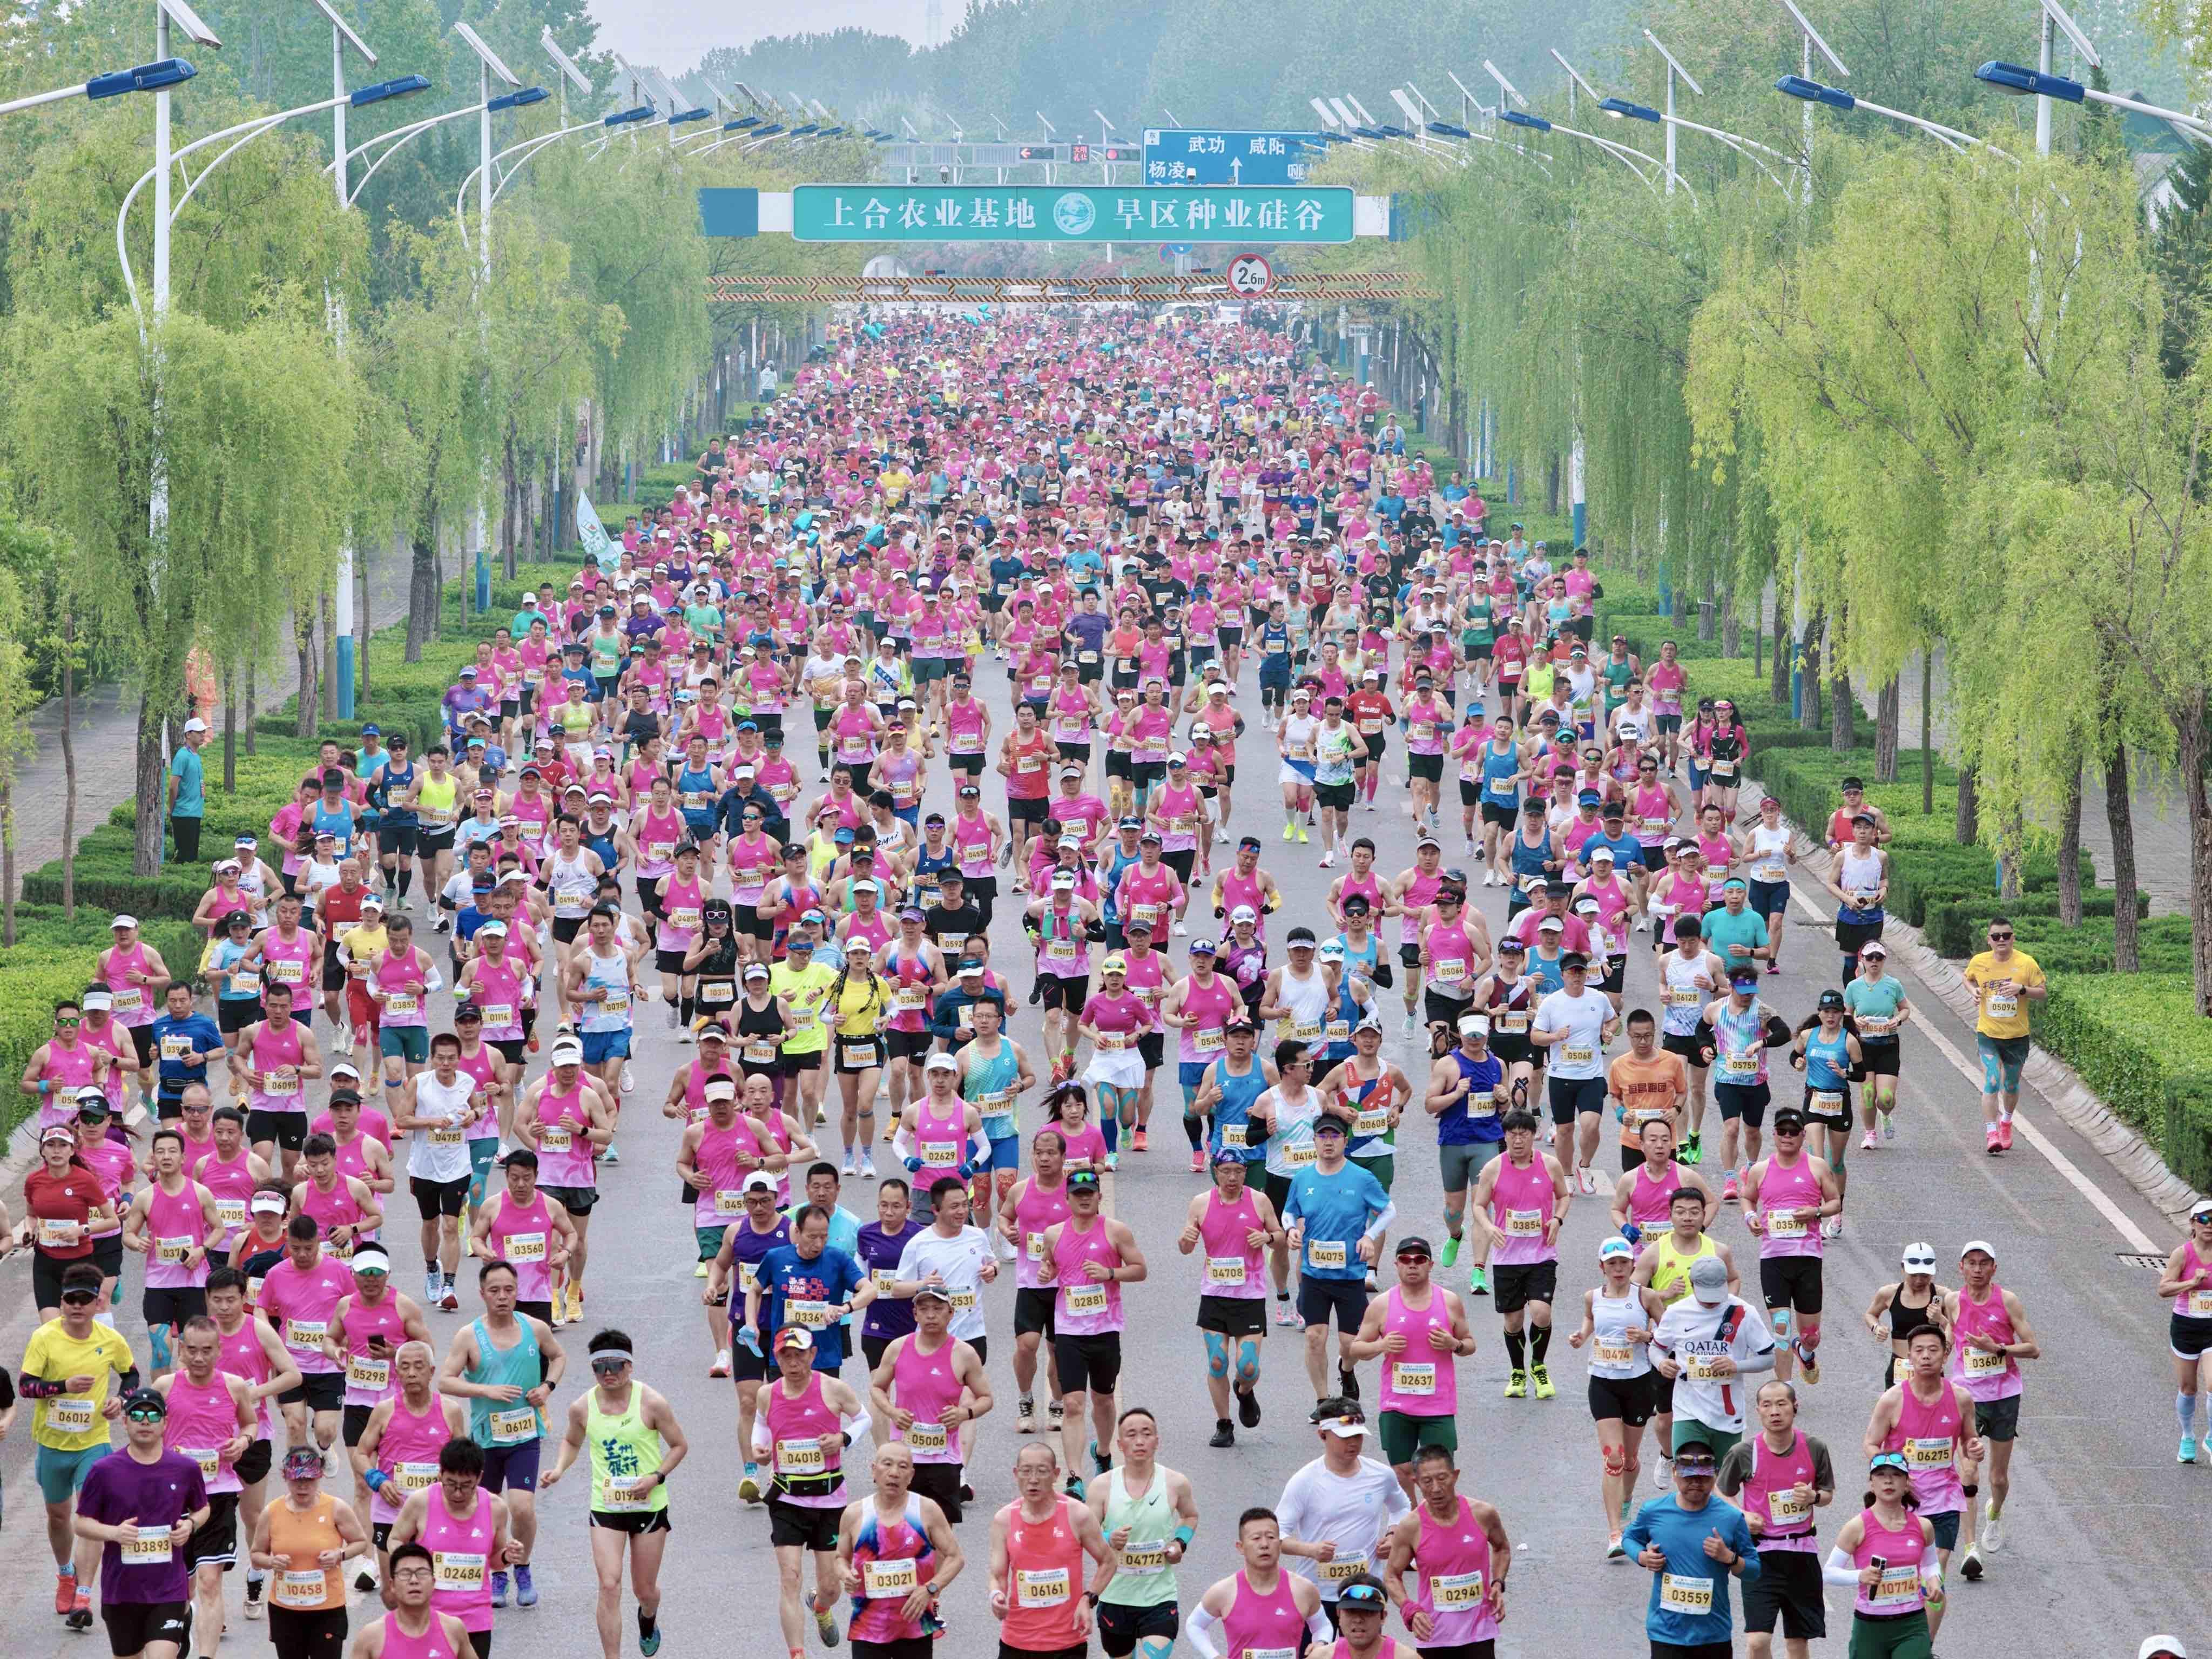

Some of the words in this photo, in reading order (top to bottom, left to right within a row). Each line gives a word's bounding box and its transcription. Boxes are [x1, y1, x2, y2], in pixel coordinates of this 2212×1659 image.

[1189, 136, 1225, 153] 武功
[1249, 136, 1285, 155] 咸阳
[1148, 160, 1185, 179] 杨凌
[824, 197, 1036, 230] 上合农业基地
[1113, 198, 1325, 231] 旱区种业硅谷
[1237, 266, 1265, 285] 2.6m
[1442, 967, 1464, 976] 05066
[393, 1001, 415, 1009] 03852
[490, 1013, 508, 1021] 01116
[1201, 1036, 1224, 1046] 05496
[751, 1049, 773, 1057] 10483
[853, 1053, 873, 1061] 11410
[1568, 1051, 1591, 1060] 05068
[1733, 1061, 1756, 1069] 05759
[1360, 1120, 1385, 1129] 00608
[436, 1133, 461, 1142] 04783
[545, 1136, 569, 1144] 02401
[929, 1151, 955, 1161] 02629
[1293, 1151, 1317, 1161] 04164
[725, 1201, 746, 1209] 045
[220, 1211, 243, 1220] 4705
[1513, 1221, 1540, 1230] 03854
[329, 1247, 352, 1259] 5646
[515, 1244, 543, 1254] 03560
[1315, 1251, 1344, 1261] 04075
[1212, 1268, 1243, 1278] 04708
[951, 1296, 973, 1306] 2531
[1075, 1294, 1103, 1307] 02881
[294, 1332, 323, 1343] 02249
[1685, 1341, 1728, 1352] QATAR
[1602, 1350, 1630, 1360] 10474
[1973, 1357, 2004, 1367] 03607
[354, 1368, 385, 1382] 05298
[1401, 1374, 1432, 1386] 02637
[58, 1413, 90, 1424] 06012
[506, 1420, 532, 1433] 06121
[912, 1434, 945, 1446] 05006
[603, 1438, 632, 1460] 兰州
[778, 1442, 783, 1451] B
[787, 1452, 821, 1464] 04018
[1917, 1450, 1948, 1461] 06275
[608, 1455, 637, 1476] 银行
[604, 1479, 610, 1487] B
[615, 1491, 646, 1501] 019
[134, 1540, 169, 1553] 03893
[435, 1554, 442, 1562] B
[1125, 1553, 1162, 1565] 04772
[444, 1568, 481, 1579] 02484
[866, 1564, 872, 1573] B
[278, 1572, 283, 1580] B
[877, 1573, 912, 1587] 03021
[1019, 1573, 1024, 1582] C
[1664, 1575, 1670, 1584] B
[1432, 1579, 1439, 1588] B
[1881, 1581, 1914, 1594] 10774
[287, 1584, 321, 1595] 10458
[1031, 1583, 1063, 1596] 06161
[1446, 1586, 1480, 1601] 02941
[1671, 1590, 1710, 1603] 03559
